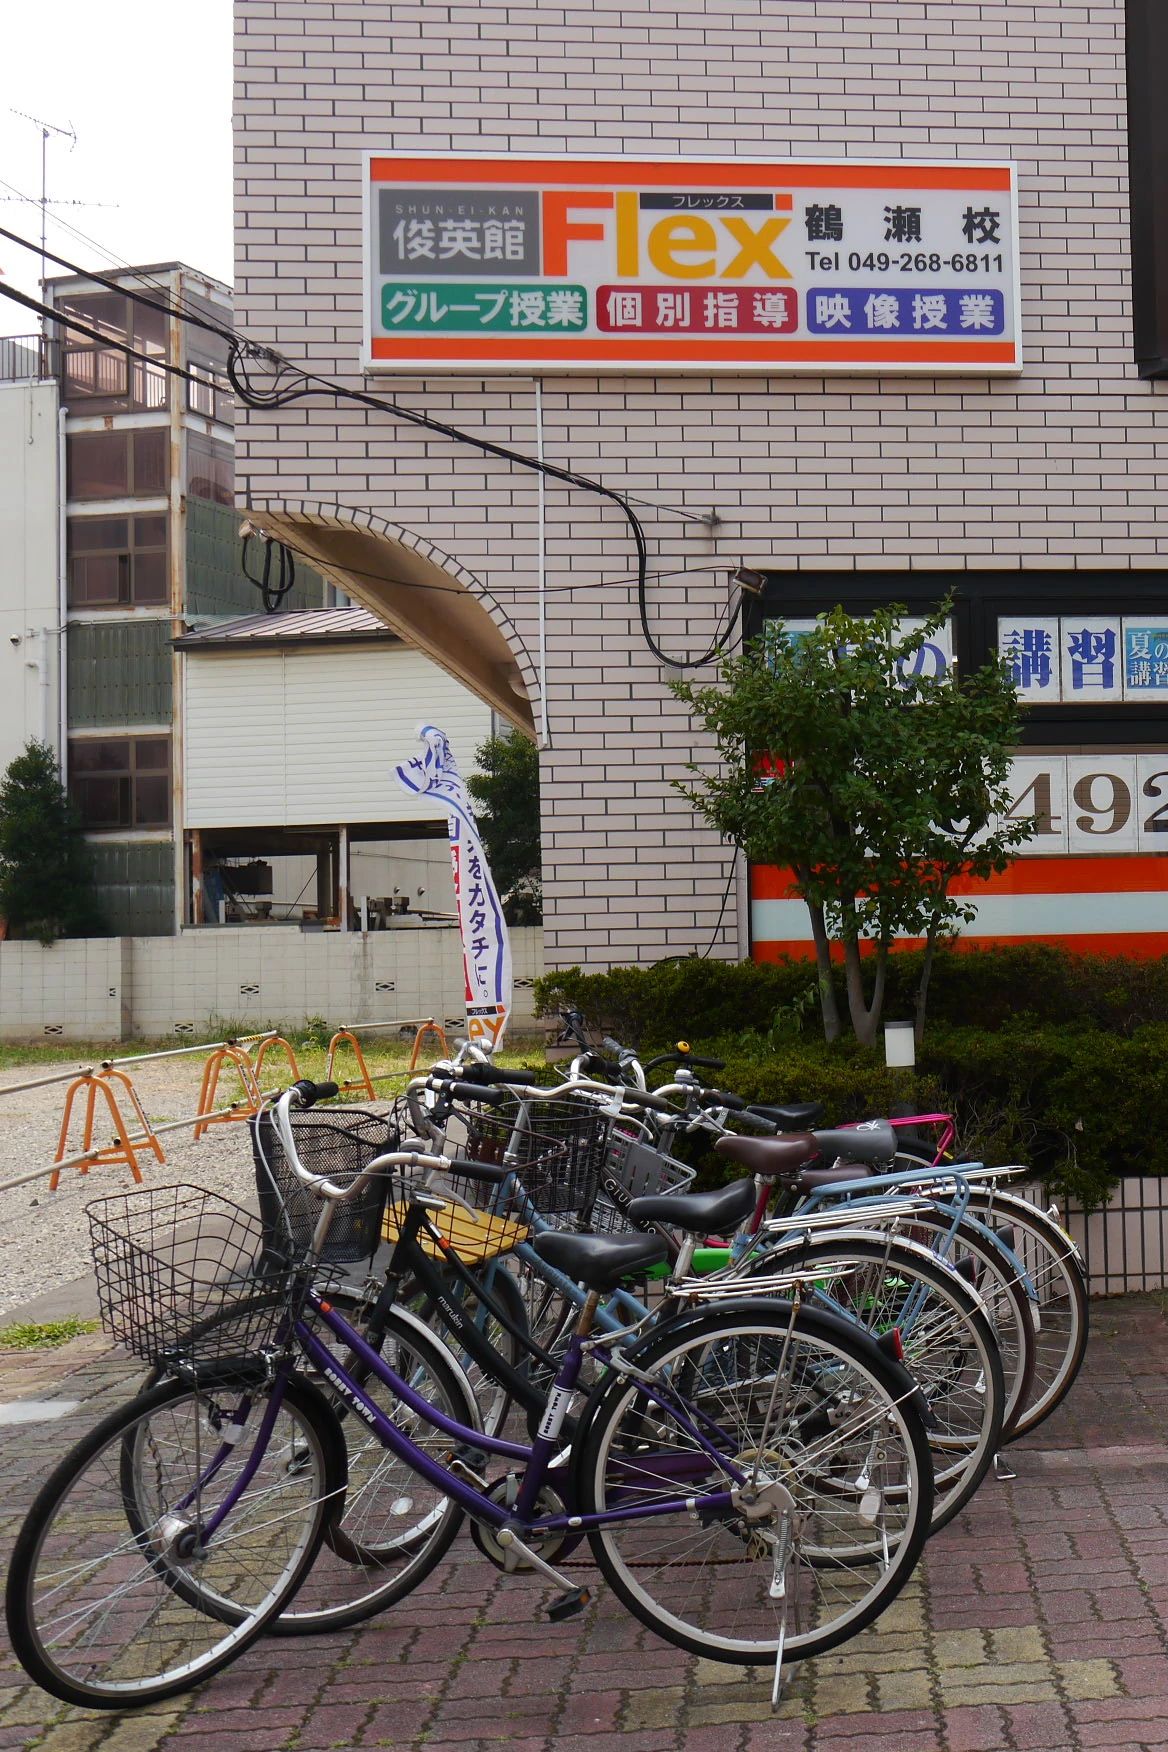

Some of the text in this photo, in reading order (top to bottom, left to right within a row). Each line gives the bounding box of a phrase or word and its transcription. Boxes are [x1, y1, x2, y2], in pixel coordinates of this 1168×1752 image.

[672, 196, 744, 208] フレックス
[392, 218, 526, 260] 俊英館
[542, 191, 793, 279] Flex
[804, 204, 1001, 244] 鶴瀬校
[805, 251, 1003, 273] Tel 049-268-6811
[386, 288, 584, 327] グループ授業
[606, 291, 789, 328] 個別指導
[815, 293, 995, 330] 映像授業
[1002, 627, 1117, 689] 講習
[438, 1296, 463, 1329] marukin
[352, 1396, 376, 1423] TOWN
